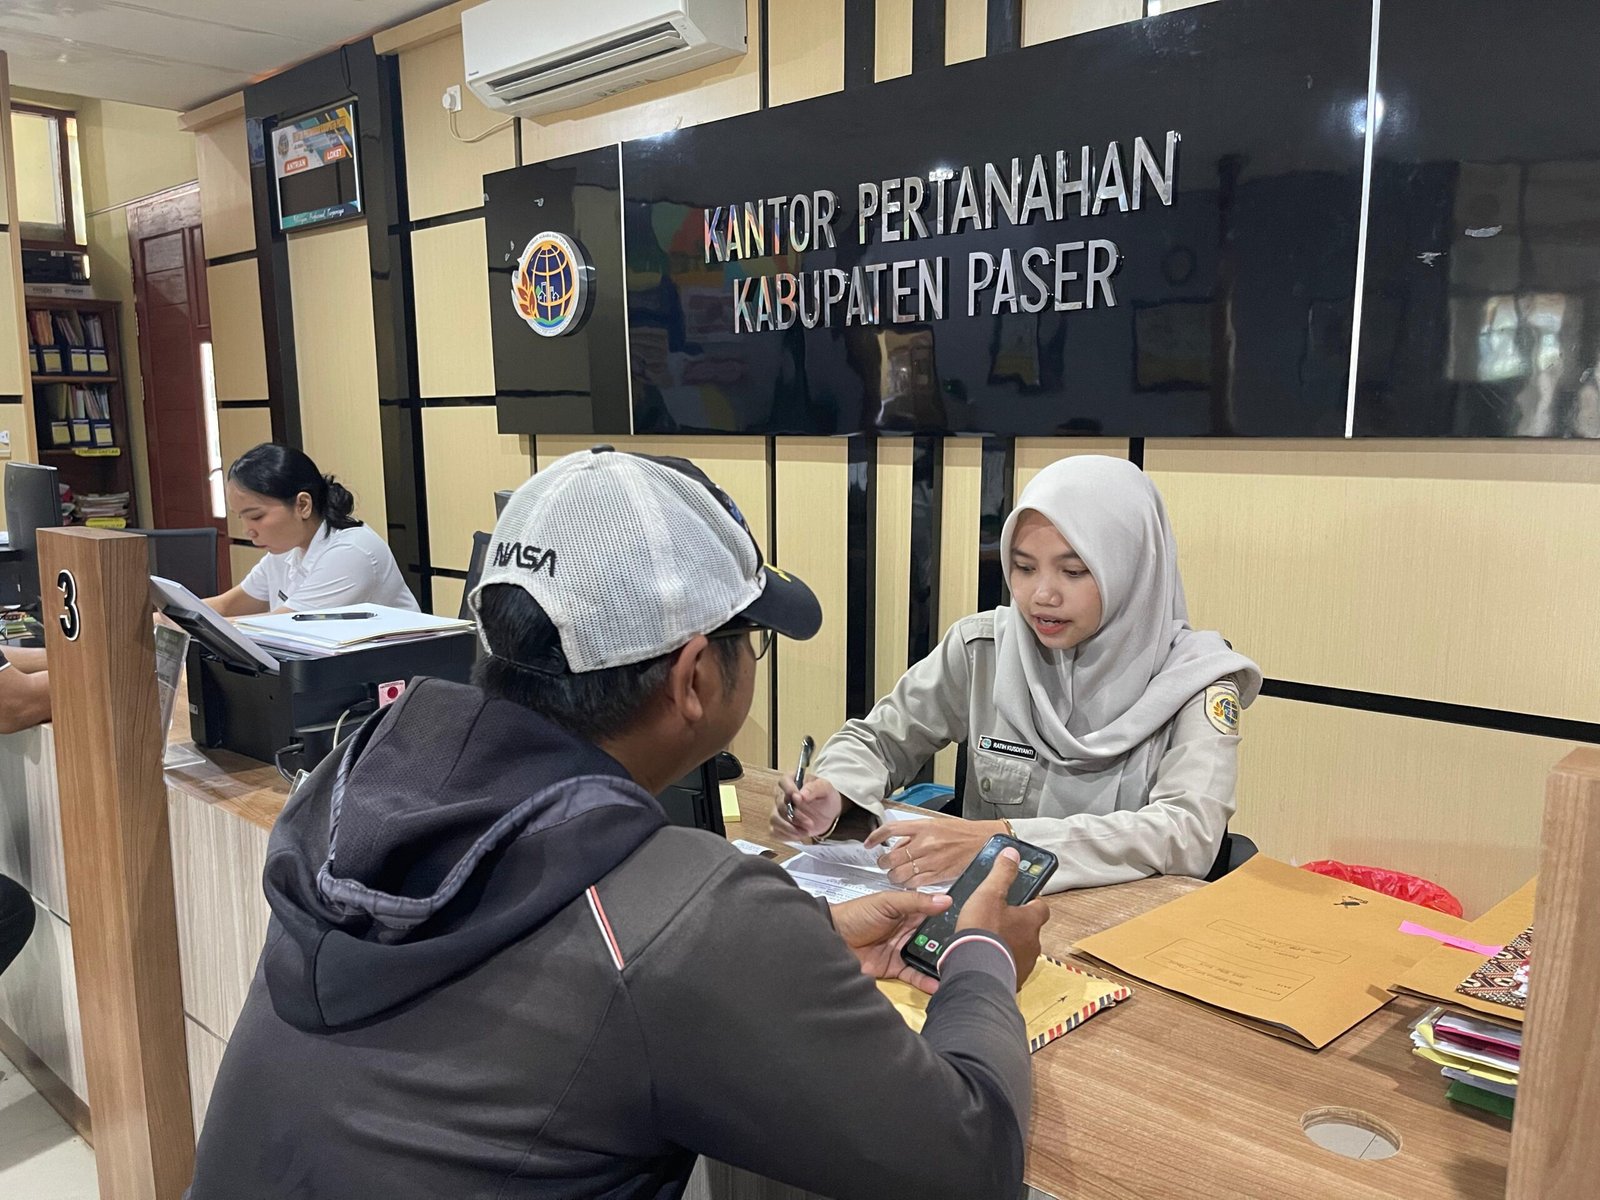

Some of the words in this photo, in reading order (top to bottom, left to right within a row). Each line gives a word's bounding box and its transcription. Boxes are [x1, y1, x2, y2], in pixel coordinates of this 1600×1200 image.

[327, 148, 342, 160] LOKET
[703, 189, 836, 264] KANTOR
[858, 130, 1179, 245] PERTANAHAN
[733, 256, 944, 334] KABUPATEN
[967, 239, 1121, 317] PASER
[493, 542, 556, 578] NASA
[57, 569, 81, 642] 3
